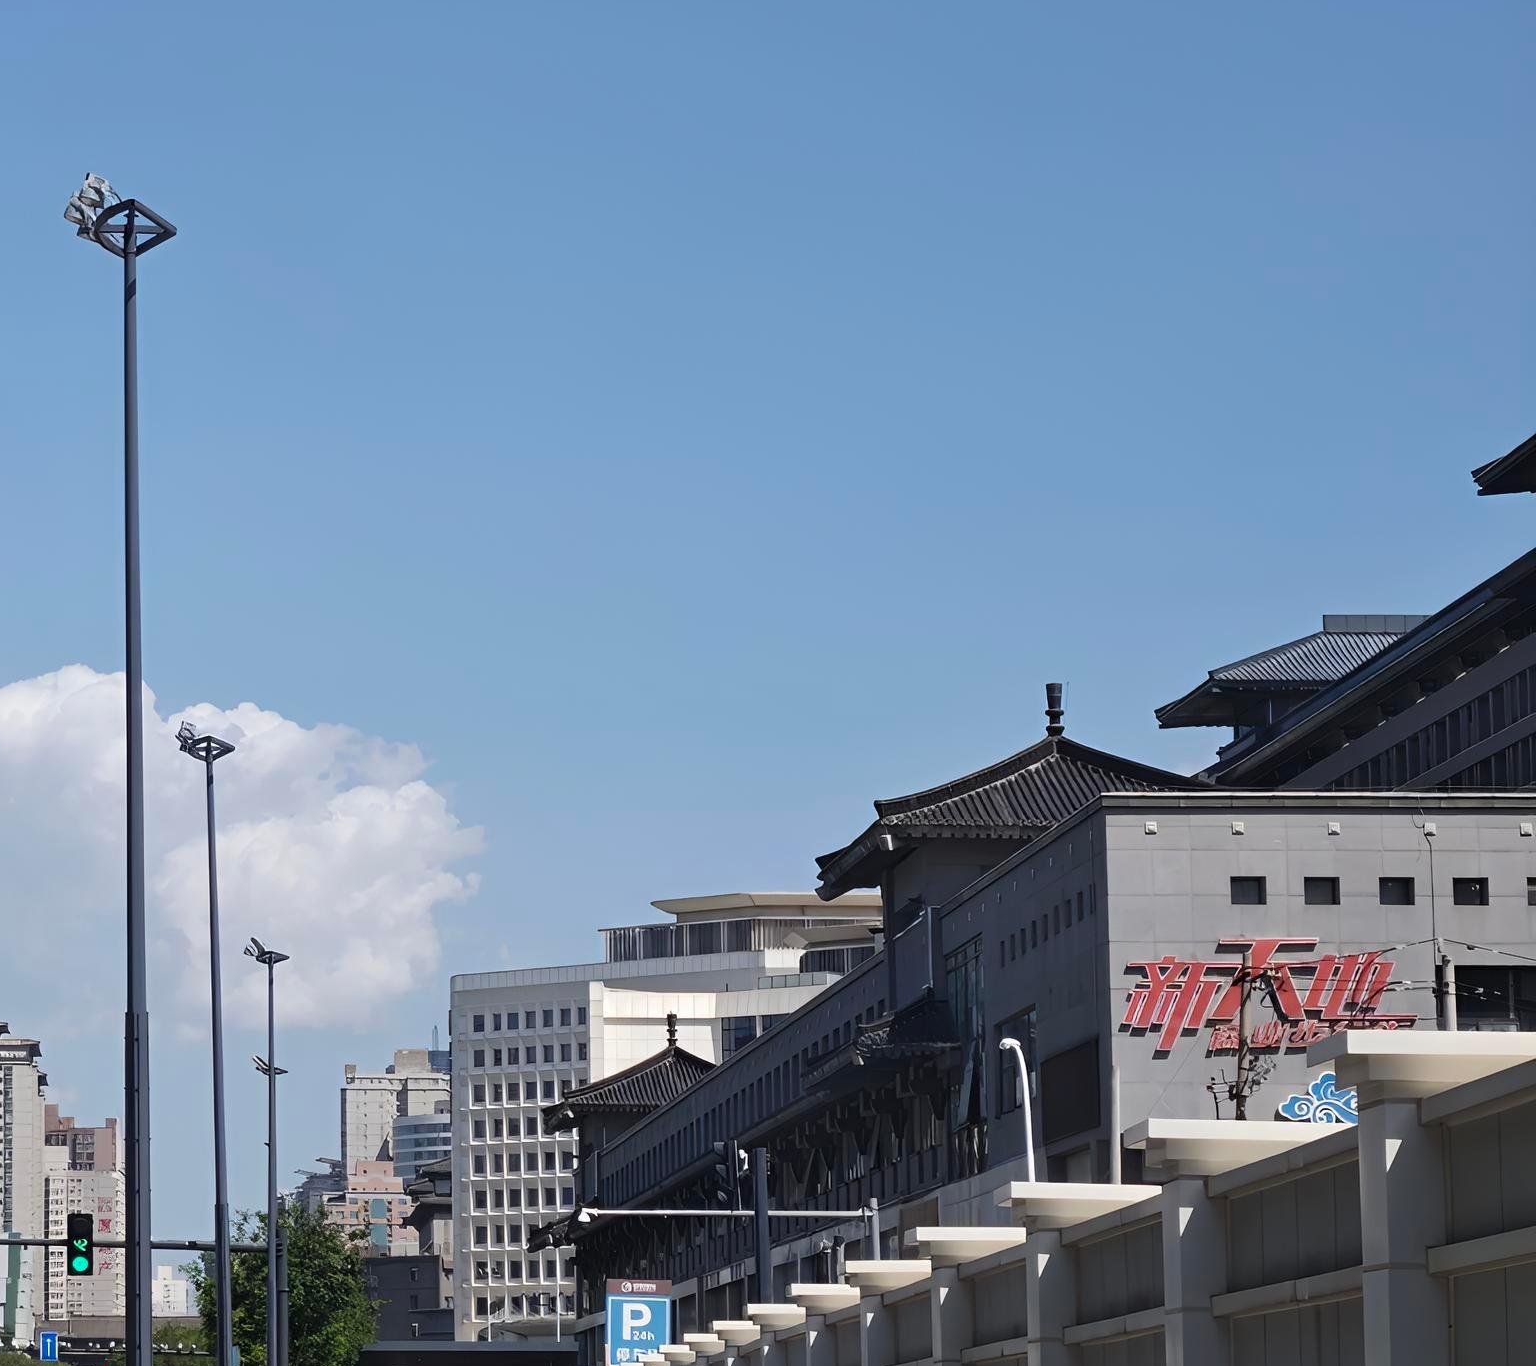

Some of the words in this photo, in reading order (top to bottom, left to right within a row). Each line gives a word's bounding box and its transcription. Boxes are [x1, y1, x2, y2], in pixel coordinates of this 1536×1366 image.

[1124, 938, 1418, 1049] 新天地
[622, 1302, 652, 1341] P
[632, 1330, 655, 1341] 24h
